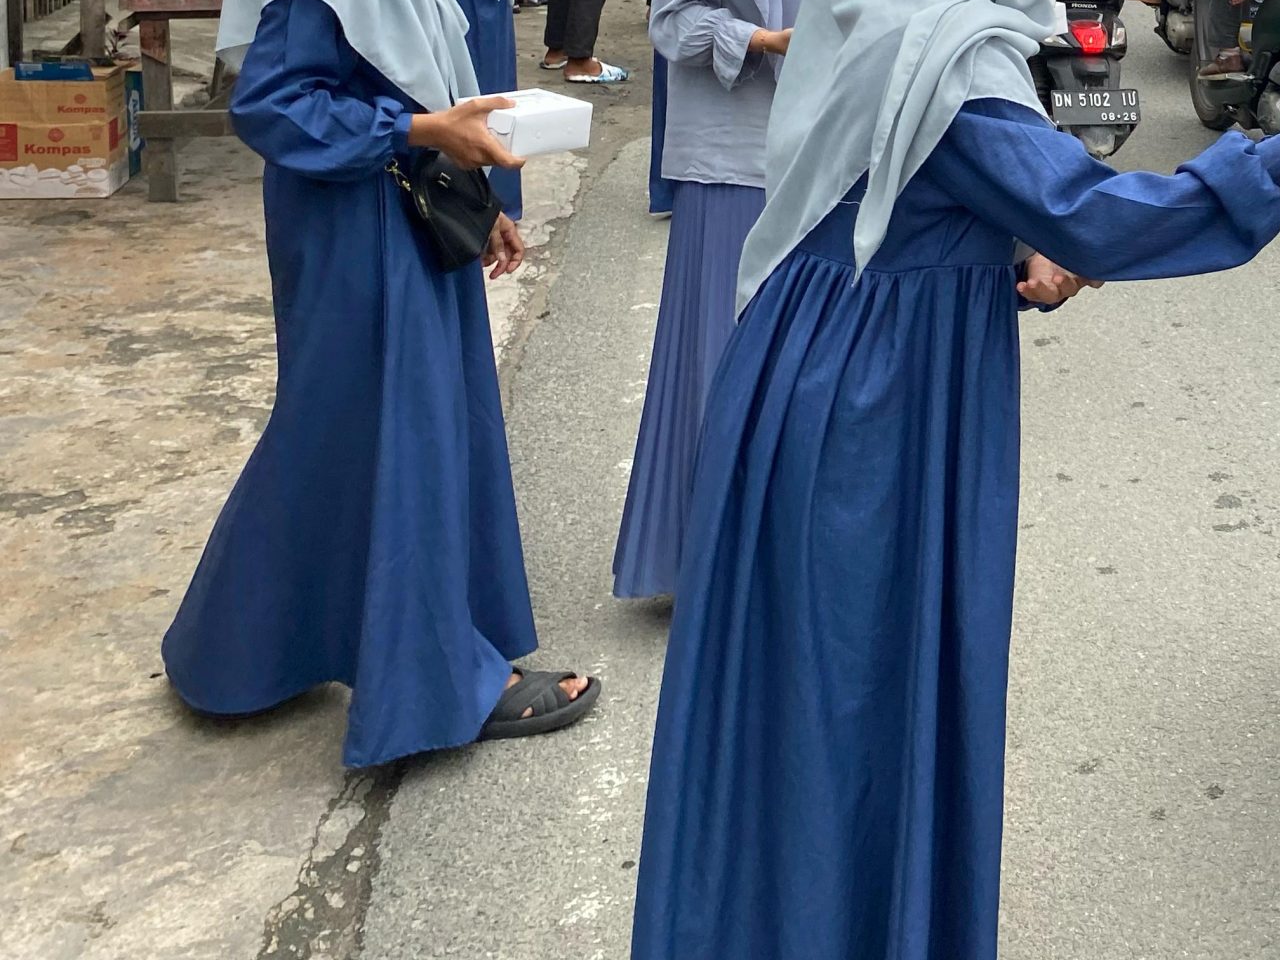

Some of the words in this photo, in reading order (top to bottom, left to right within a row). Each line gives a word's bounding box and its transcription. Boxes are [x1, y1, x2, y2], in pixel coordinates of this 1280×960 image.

[1055, 93, 1072, 107] DN
[1079, 92, 1111, 107] 5102
[57, 105, 106, 115] Kompas
[24, 144, 92, 156] Kompas
